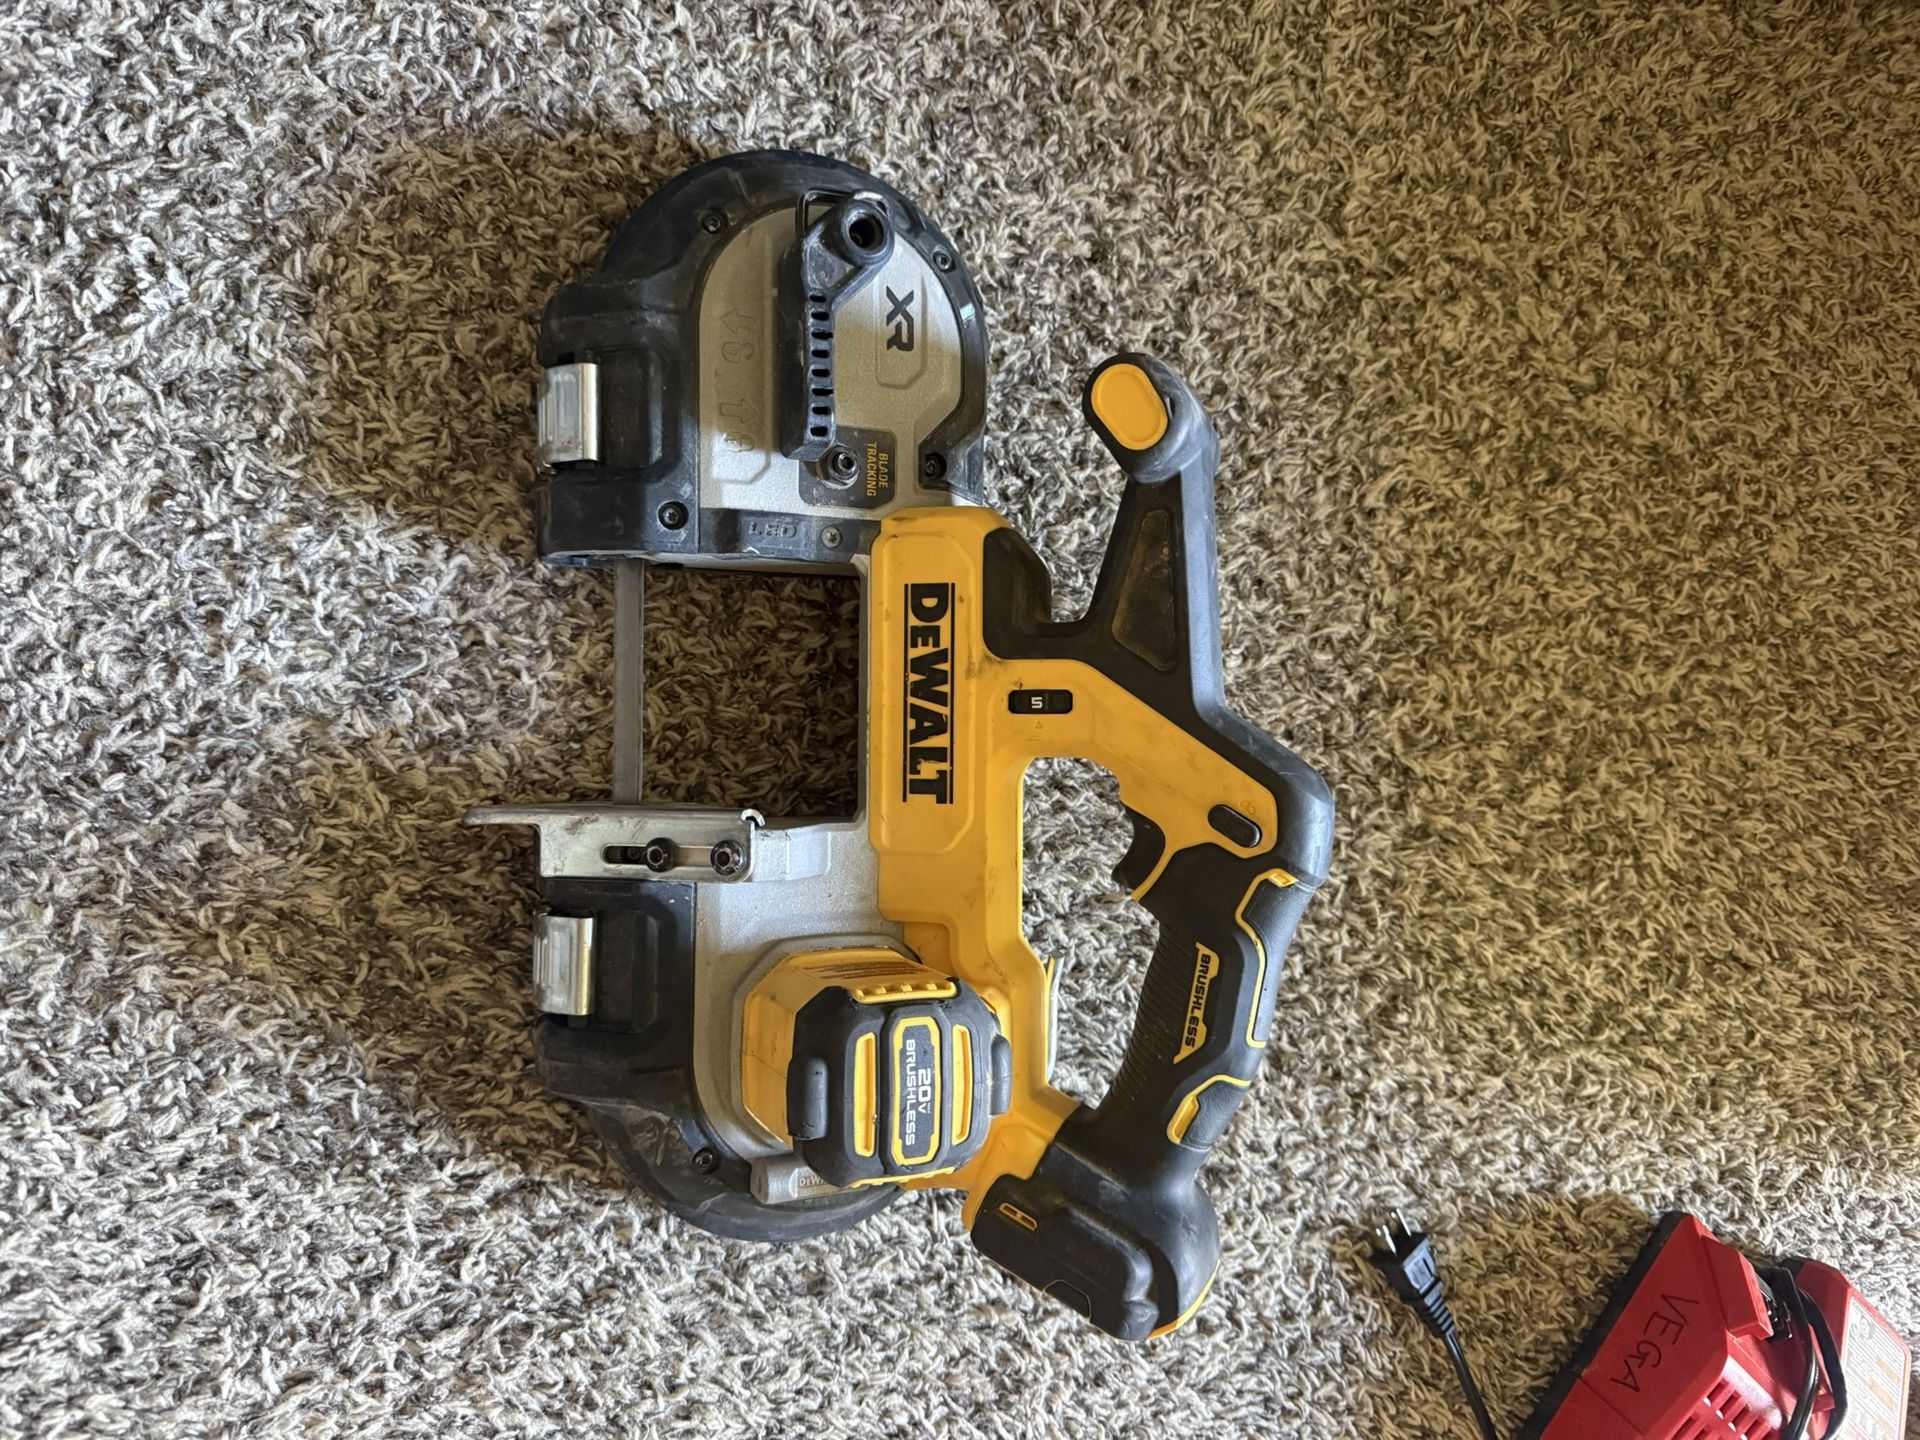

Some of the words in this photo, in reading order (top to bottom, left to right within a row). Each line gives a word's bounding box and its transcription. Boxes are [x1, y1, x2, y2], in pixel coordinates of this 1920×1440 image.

[886, 285, 915, 352] XR
[866, 442, 877, 498] TRACKING
[878, 453, 889, 489] BLADE
[1031, 696, 1044, 709] 5
[1184, 953, 1212, 1048] BRUSHLESS
[905, 1038, 916, 1146] BRUSHLESS
[1609, 1294, 1700, 1392] VEGA
